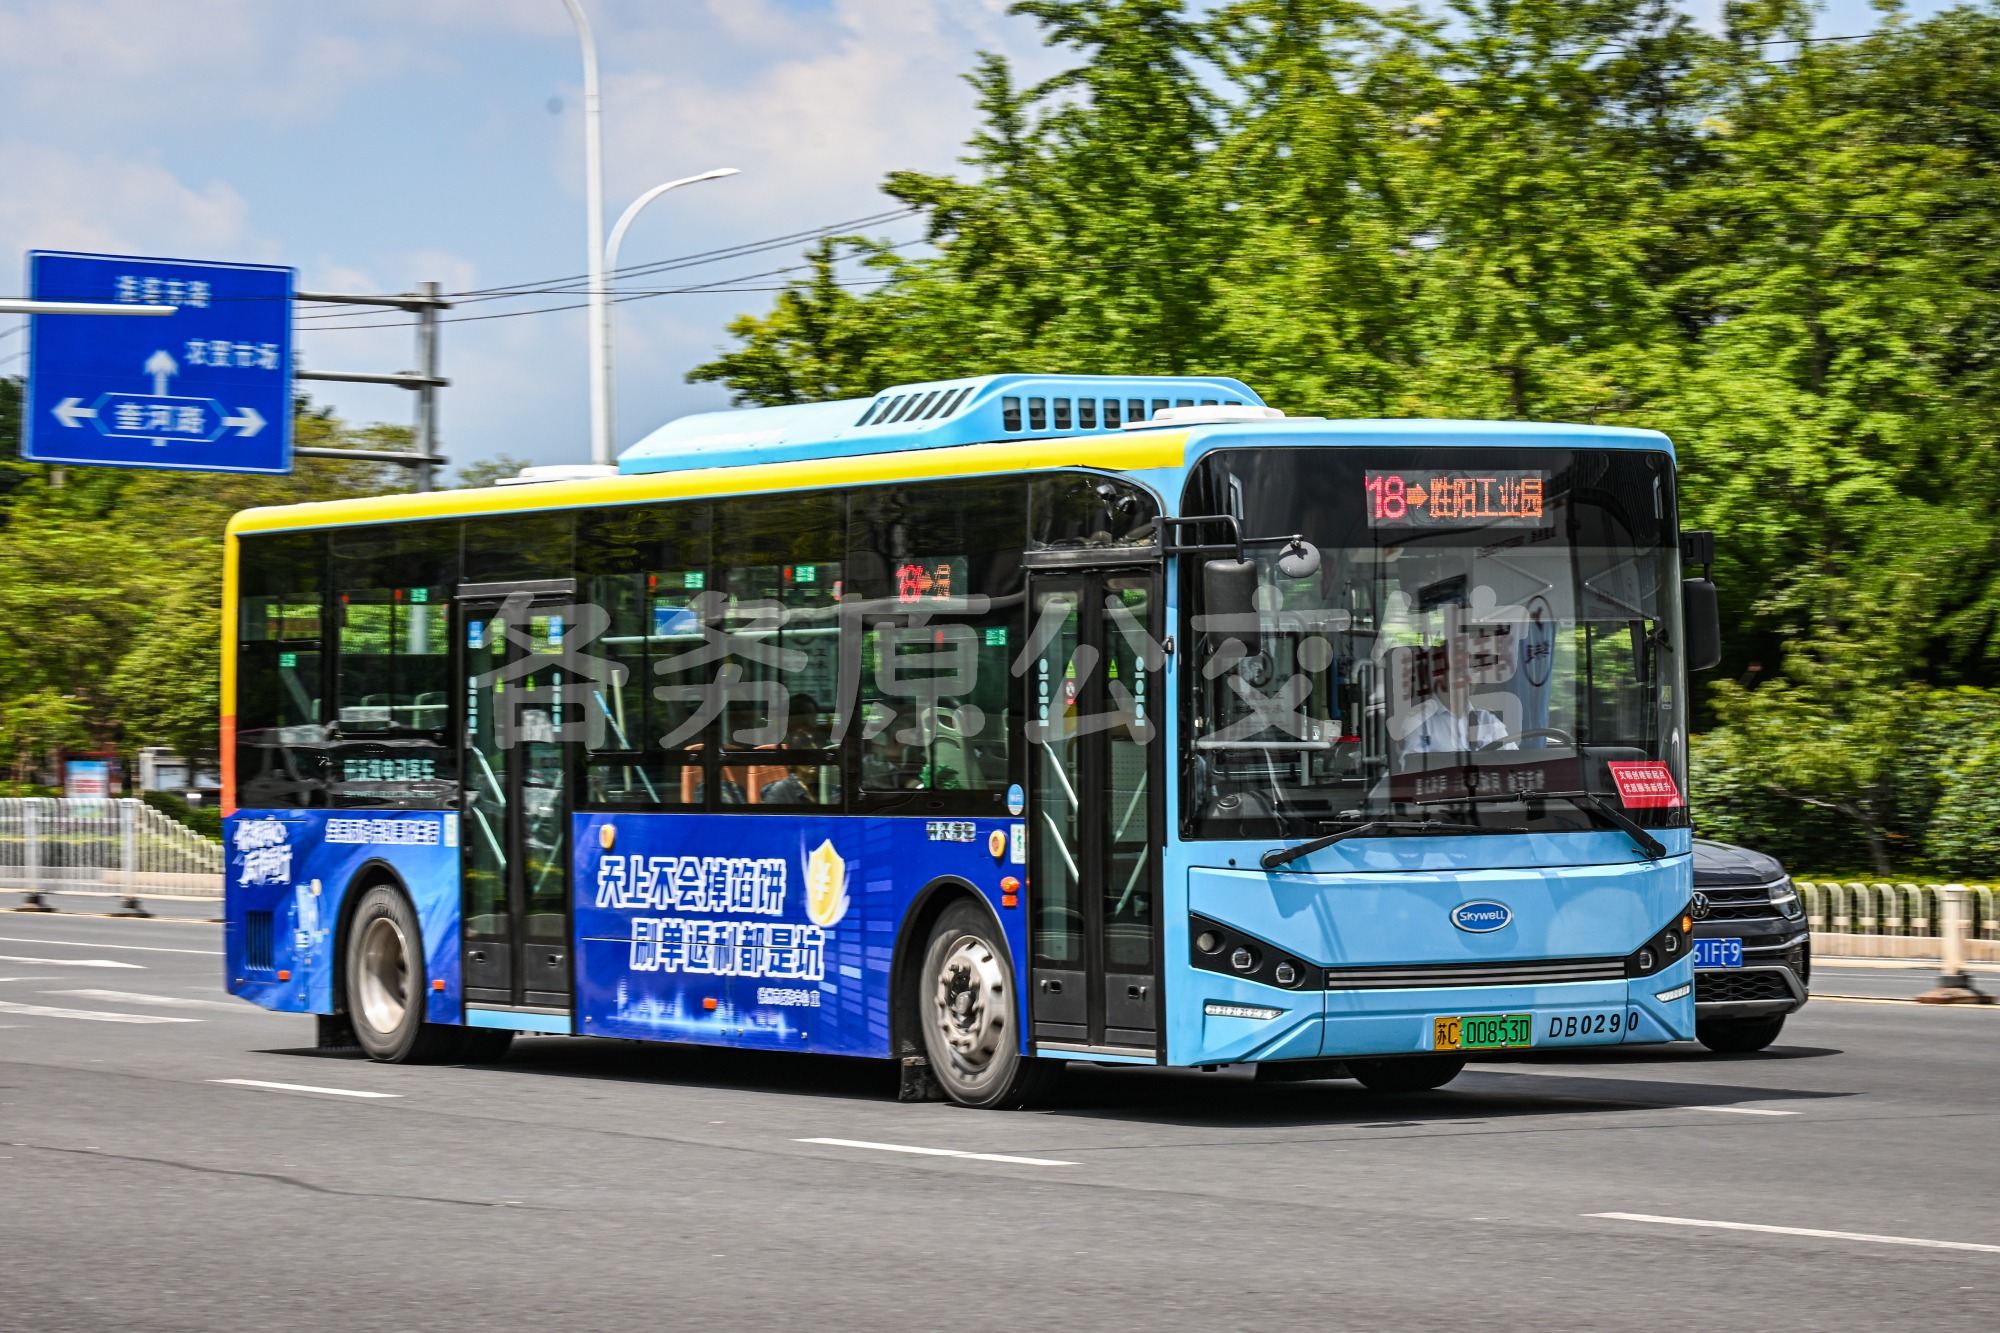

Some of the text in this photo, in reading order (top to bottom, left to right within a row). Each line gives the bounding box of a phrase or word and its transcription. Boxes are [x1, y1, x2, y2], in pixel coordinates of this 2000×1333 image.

[1365, 476, 1406, 518] 18
[596, 855, 787, 915] 天上不会掉馅饼
[629, 917, 825, 981] 刷单返利都是坑
